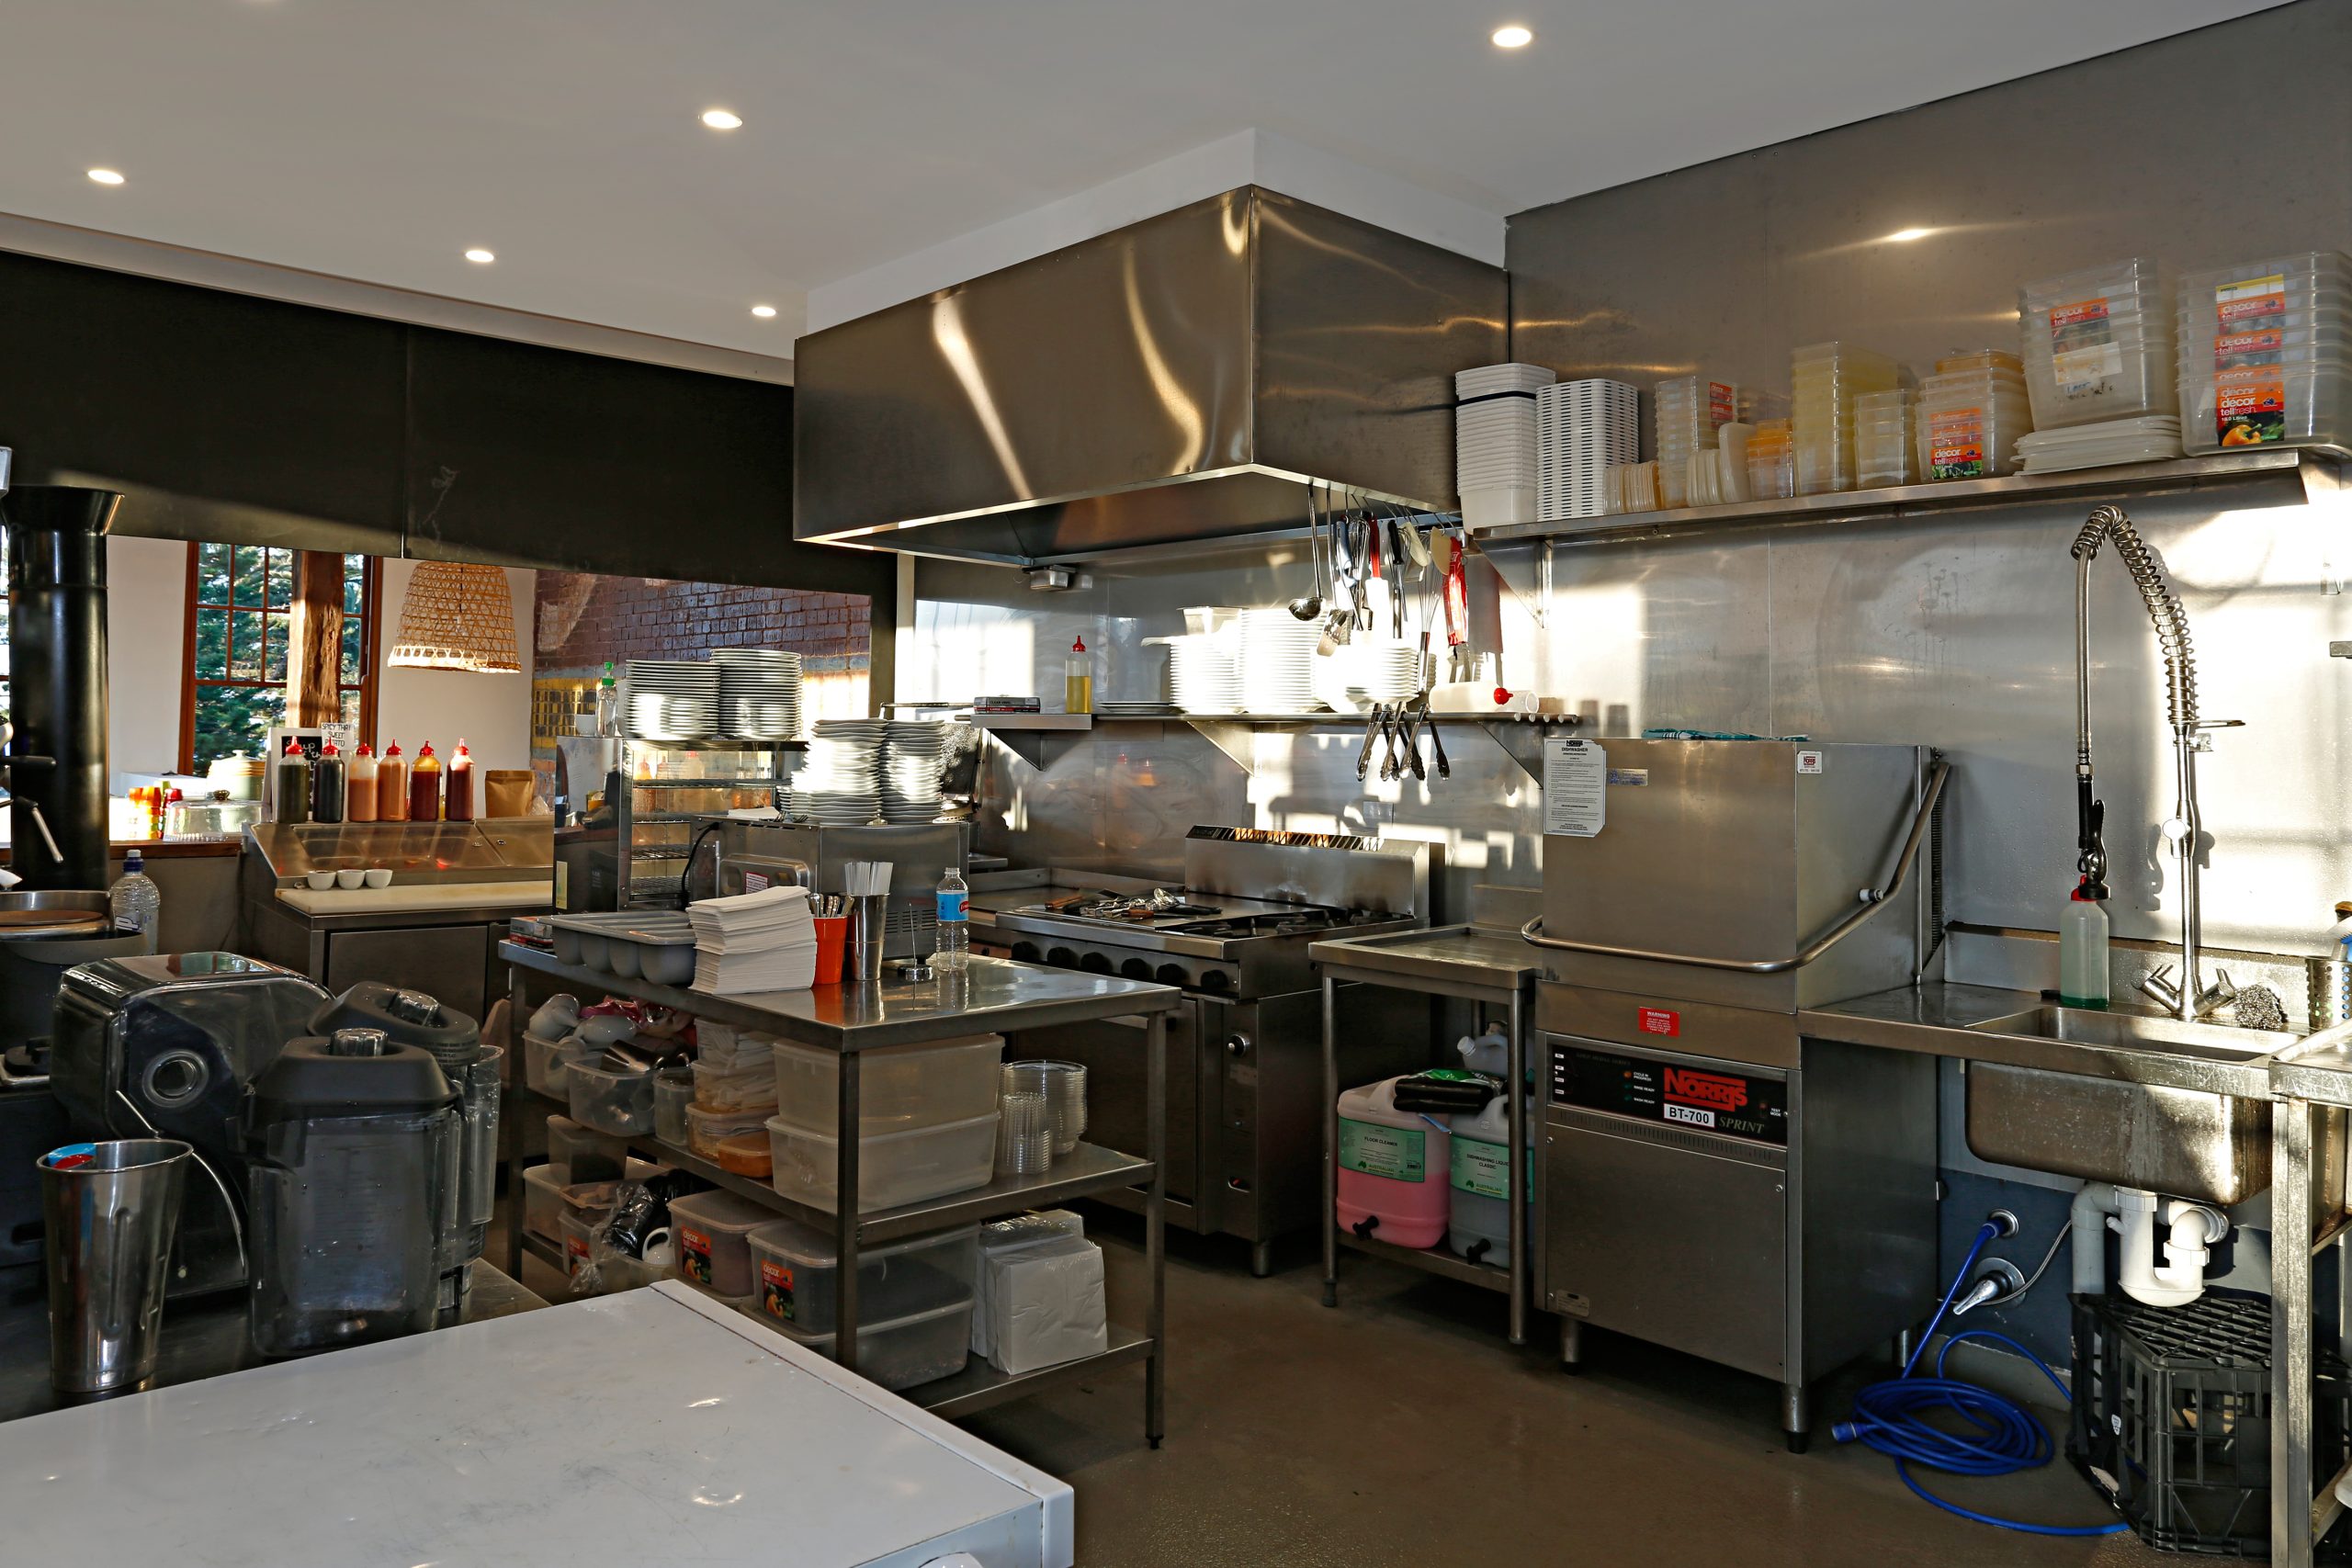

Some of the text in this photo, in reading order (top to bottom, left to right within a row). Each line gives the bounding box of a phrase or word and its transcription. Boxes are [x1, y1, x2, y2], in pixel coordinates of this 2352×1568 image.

[2222, 396, 2256, 408] décor
[2221, 405, 2256, 416] tellfresh
[324, 739, 345, 748] PTATO
[1669, 1107, 1709, 1123] BT-700
[1719, 1116, 1765, 1134] SPRINT
